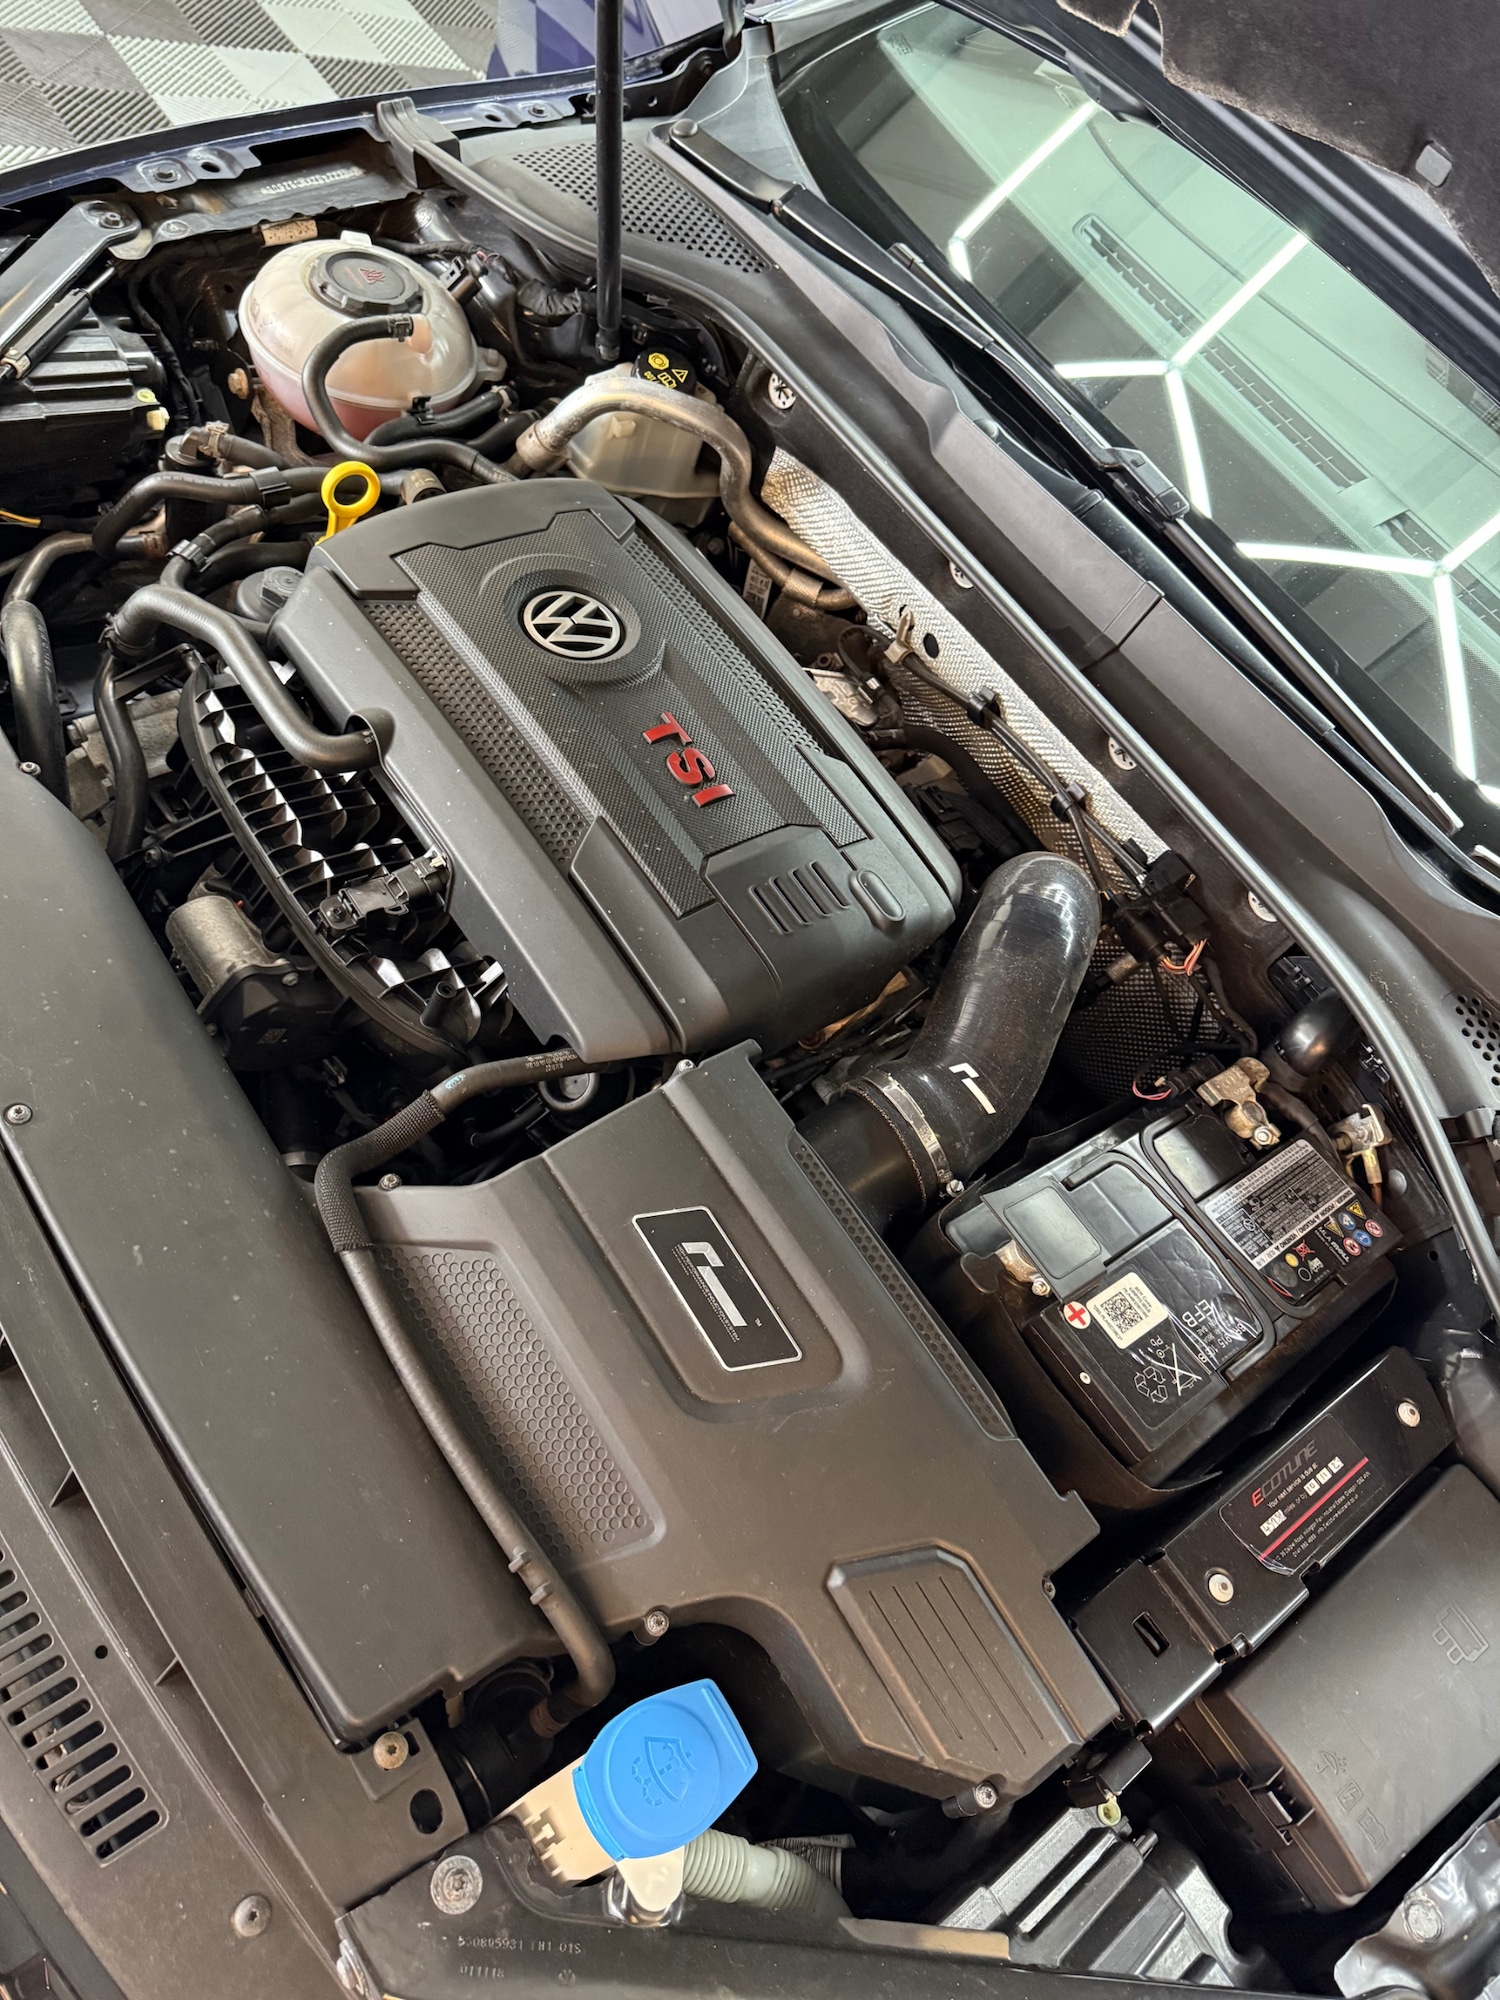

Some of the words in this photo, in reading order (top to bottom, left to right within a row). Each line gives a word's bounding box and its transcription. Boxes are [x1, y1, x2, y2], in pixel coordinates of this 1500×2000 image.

[642, 711, 735, 807] TSI
[1335, 1189, 1352, 1203] DANGER
[1319, 1202, 1335, 1217] POISON
[1297, 1217, 1316, 1233] PELIGRO
[1179, 1297, 1214, 1329] EFB
[1148, 1334, 1163, 1349] Pb
[1252, 1440, 1318, 1507] ECOTUNE
[1266, 1495, 1280, 1509] Your
[1276, 1488, 1288, 1500] next
[1285, 1476, 1302, 1493] service
